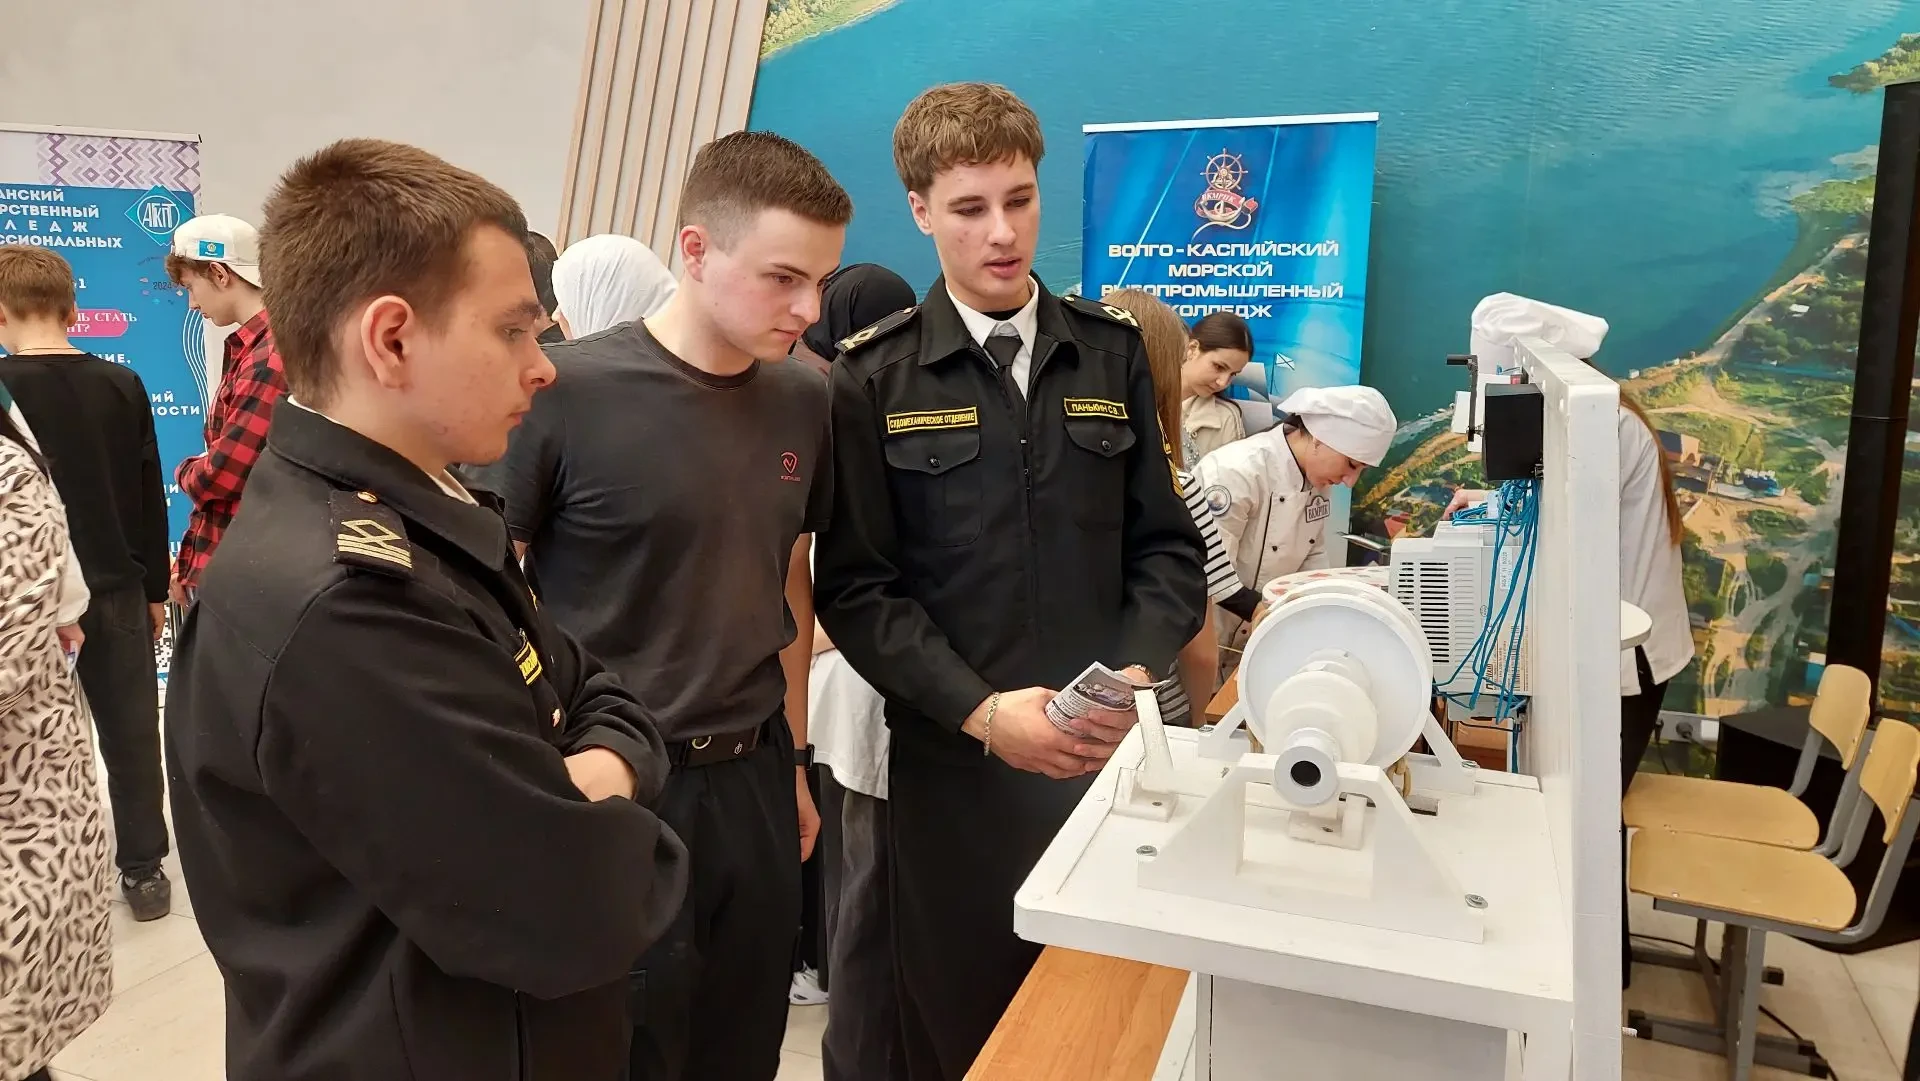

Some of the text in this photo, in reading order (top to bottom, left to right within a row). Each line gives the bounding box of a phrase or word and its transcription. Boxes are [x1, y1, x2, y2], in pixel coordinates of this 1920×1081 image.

[1108, 243, 1173, 258] ВОЛГО
[1186, 240, 1339, 257] КАСПИЙСКИЙ
[1168, 261, 1273, 277] МОРСКОЙ
[94, 312, 137, 322] СТАТЬ
